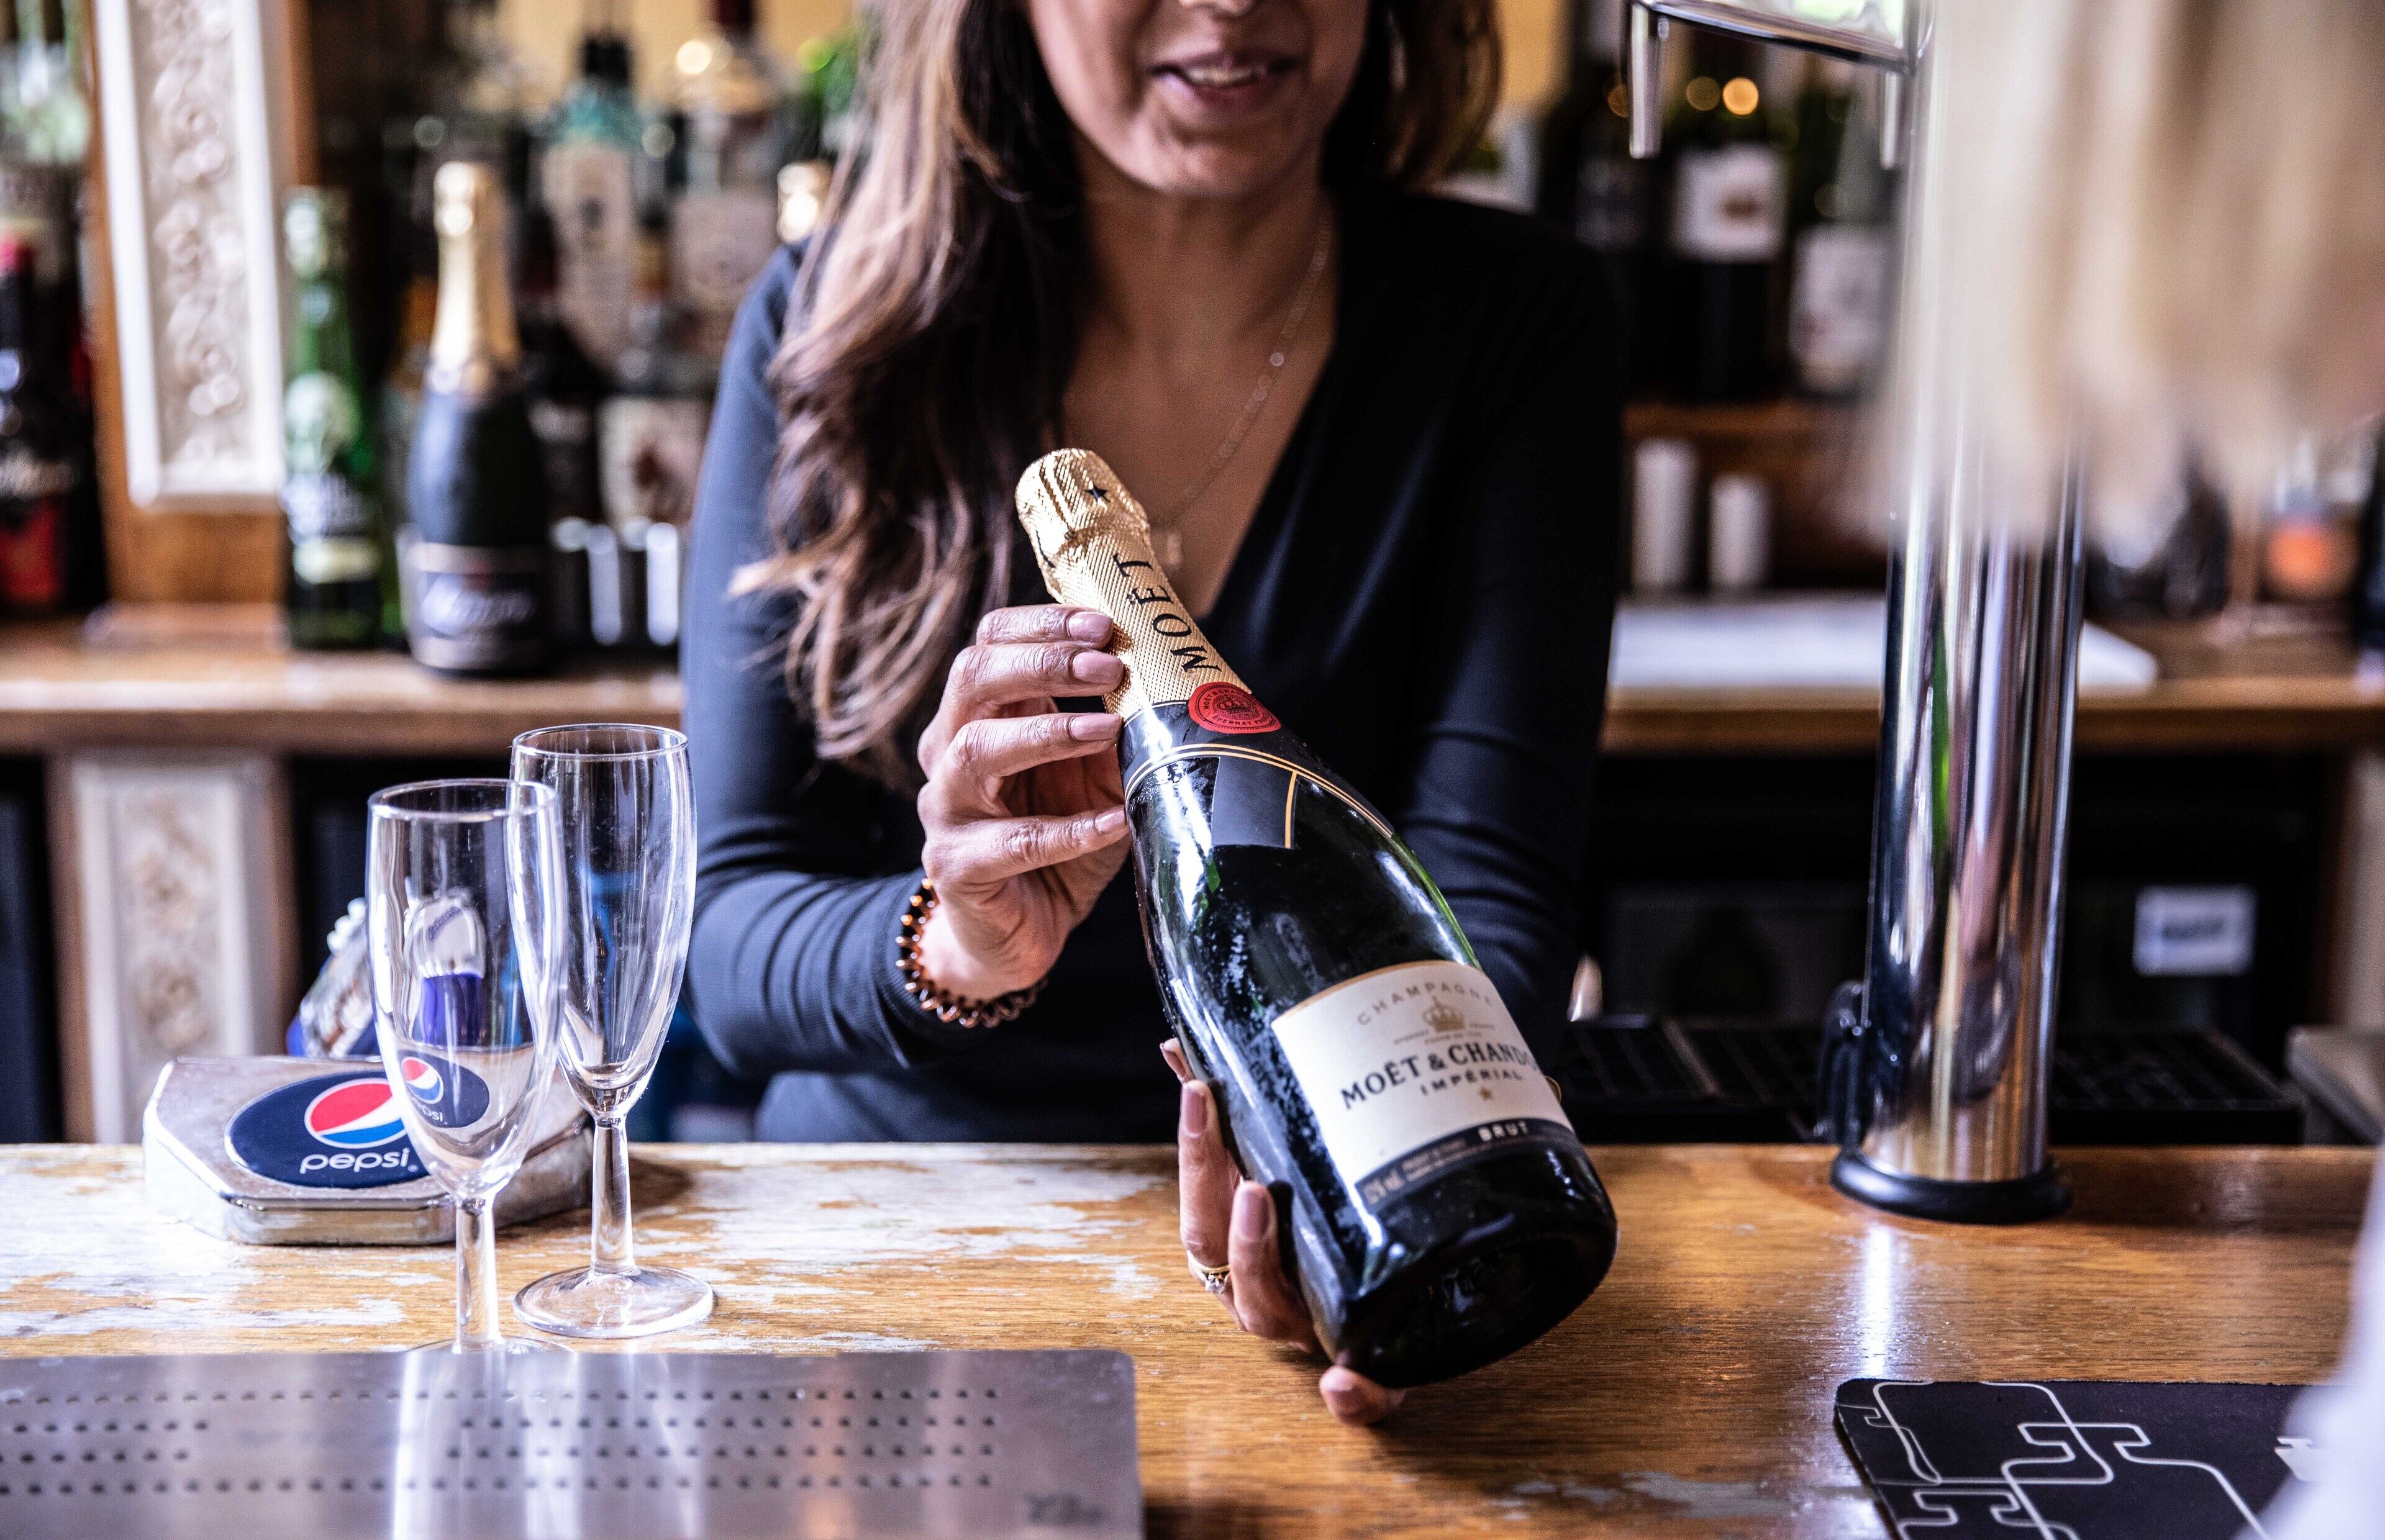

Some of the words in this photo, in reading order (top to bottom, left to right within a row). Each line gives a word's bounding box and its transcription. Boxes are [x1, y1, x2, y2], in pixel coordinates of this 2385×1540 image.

[1113, 554, 1222, 673] MOËT
[1428, 1053, 1446, 1071] &
[1478, 1120, 1527, 1141] BRUT
[299, 1148, 411, 1174] pepsi
